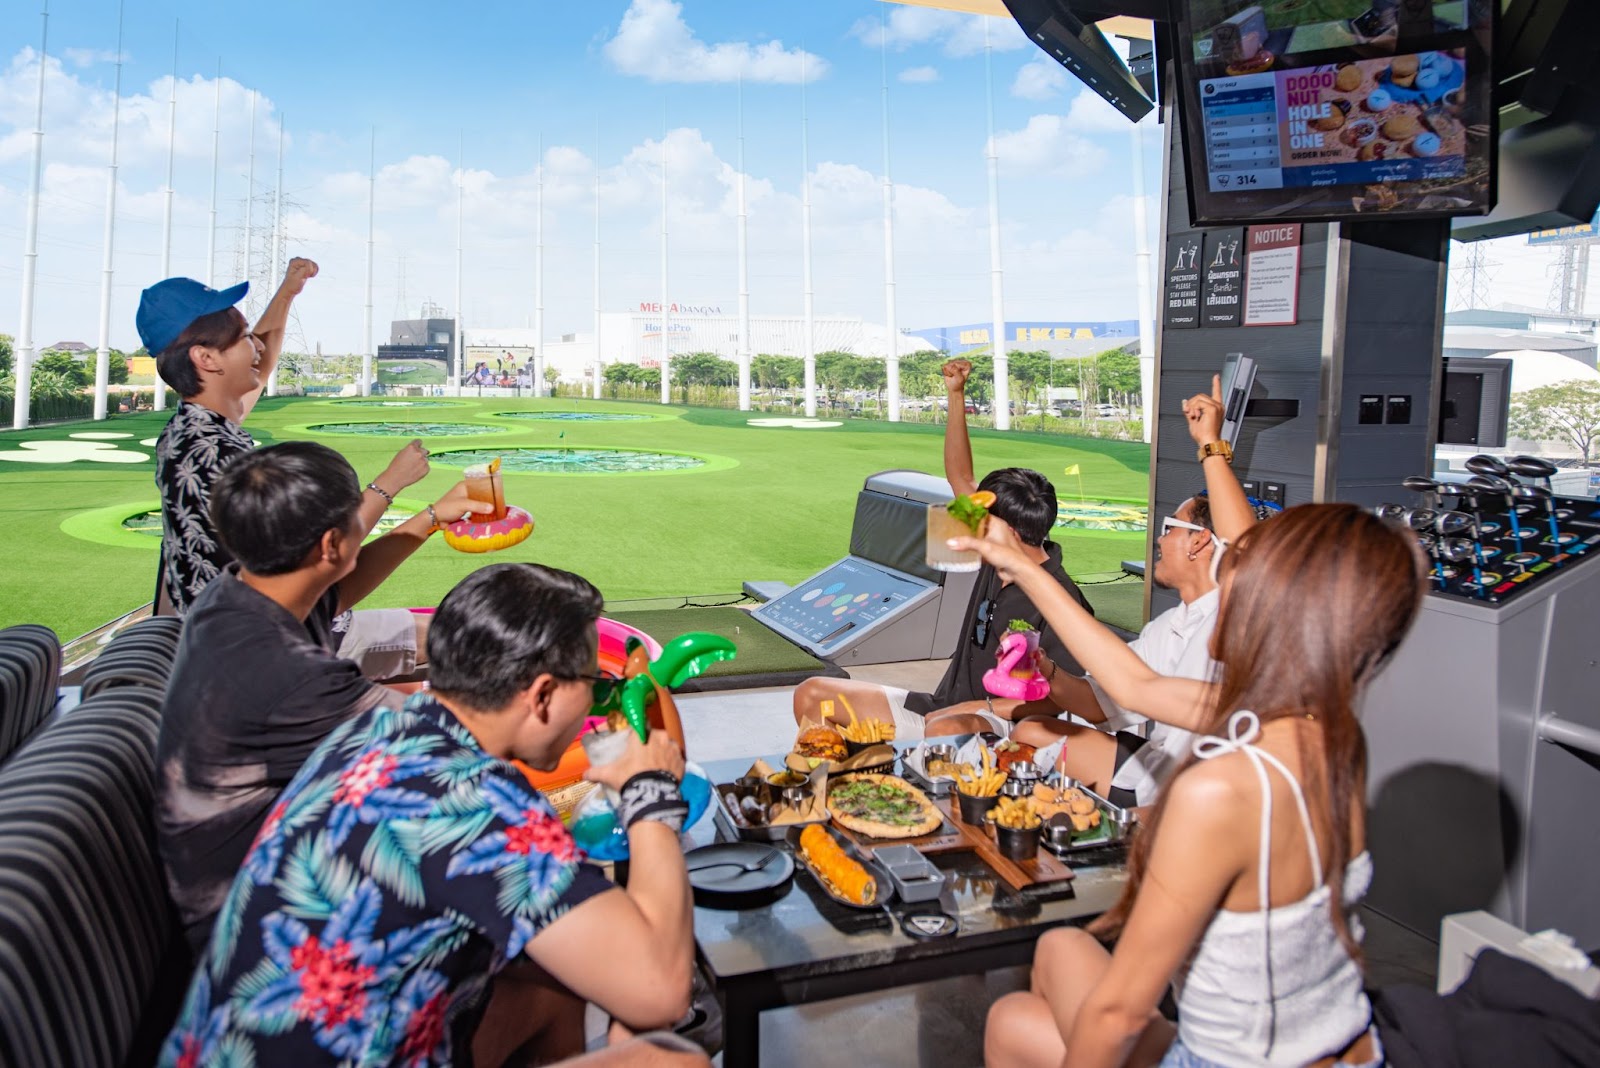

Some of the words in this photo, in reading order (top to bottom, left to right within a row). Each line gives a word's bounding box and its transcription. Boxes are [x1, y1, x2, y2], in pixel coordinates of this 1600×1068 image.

[1286, 73, 1332, 91] DOOO
[1287, 90, 1320, 106] NUT
[1288, 102, 1332, 120] HOLE
[1289, 120, 1307, 135] IN
[1290, 133, 1324, 149] ONE
[1291, 151, 1318, 160] ORDER
[1237, 175, 1257, 185] 314
[1254, 227, 1293, 244] NOTICE
[1170, 273, 1198, 282] SPECTATORS
[1181, 290, 1197, 298] BEHIND
[640, 302, 679, 313] MEA
[1169, 299, 1182, 308] RED
[1182, 298, 1197, 307] LINE
[960, 329, 990, 345] IKEA
[1016, 327, 1095, 341] IKEA
